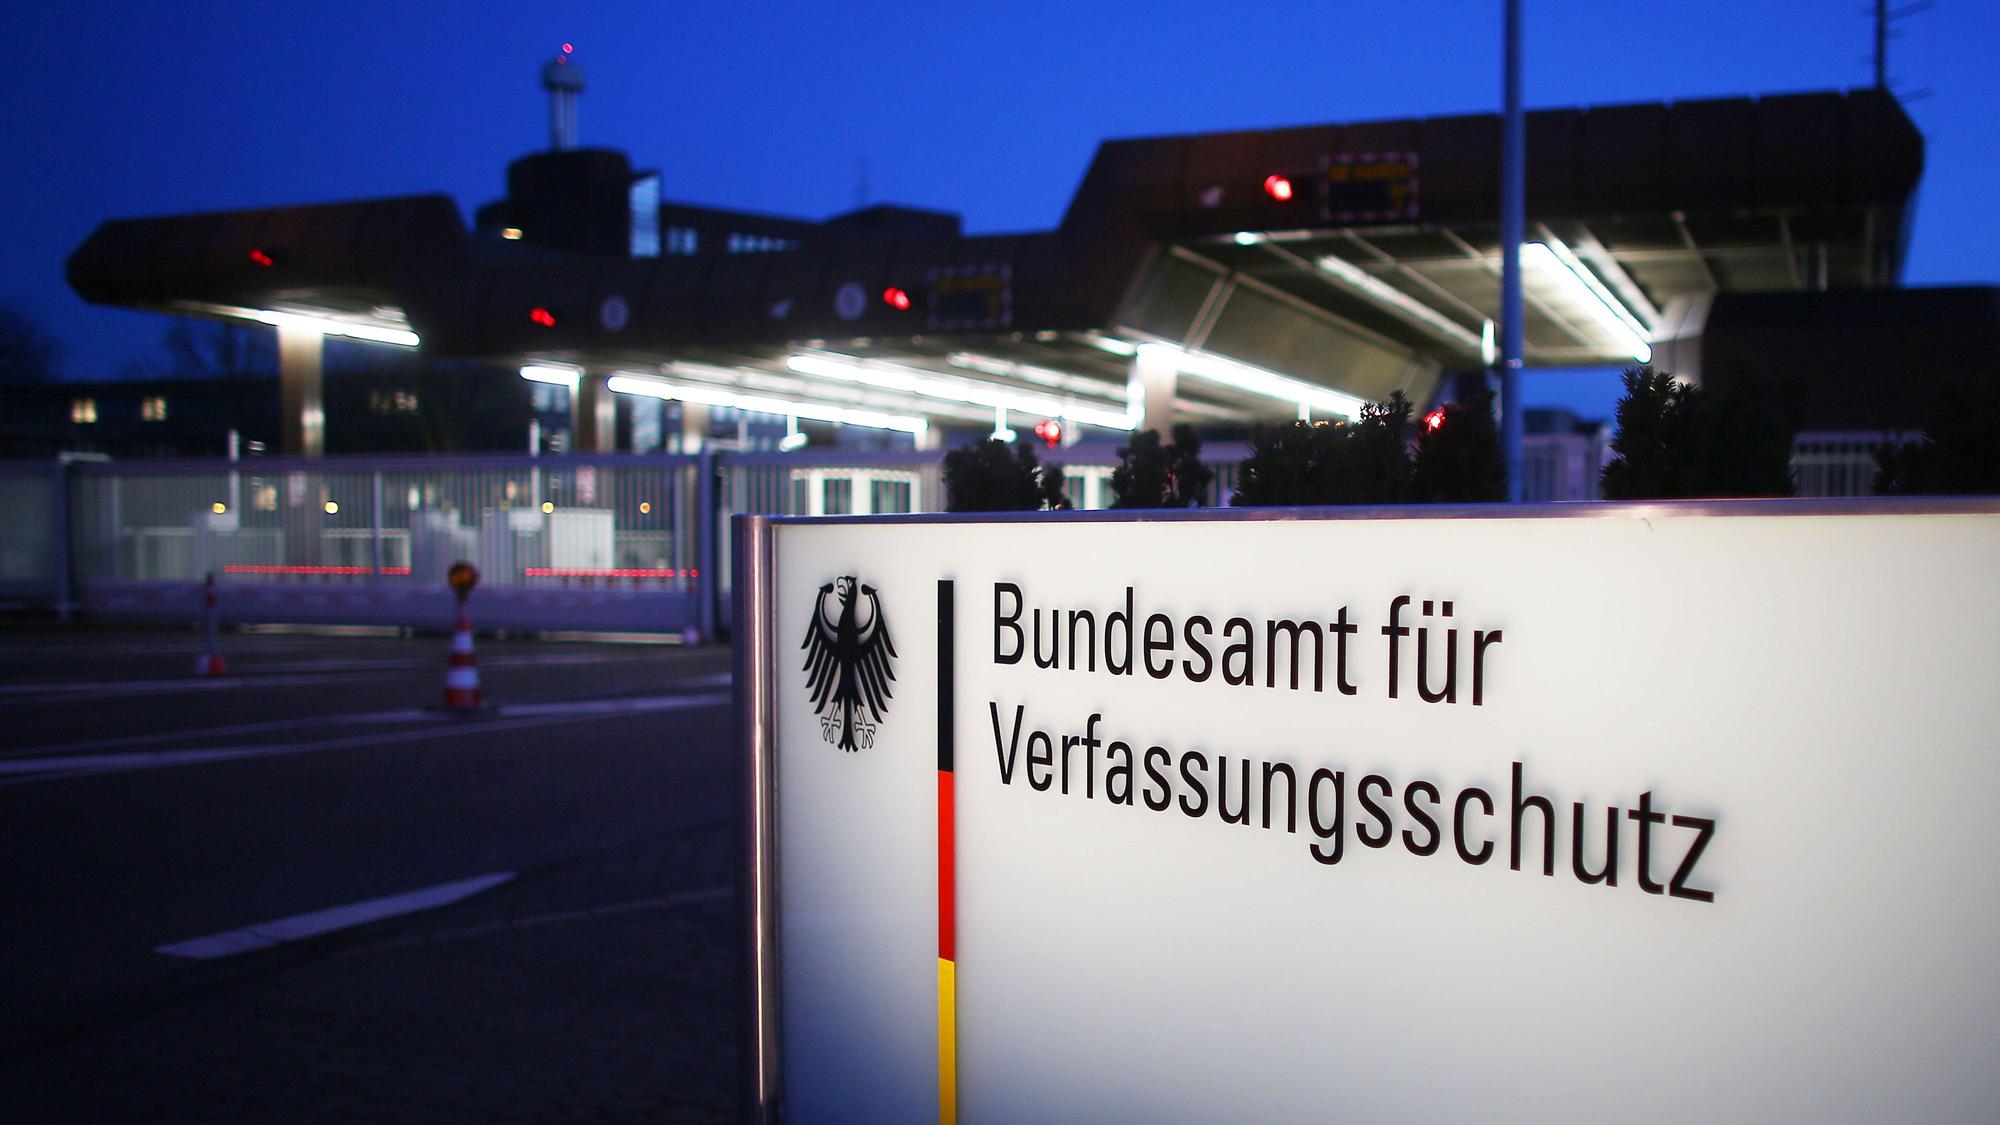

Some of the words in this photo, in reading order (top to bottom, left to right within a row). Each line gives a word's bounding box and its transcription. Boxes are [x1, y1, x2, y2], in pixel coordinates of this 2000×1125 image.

[993, 582, 1358, 696] Bundesamt
[1381, 595, 1503, 706] für
[989, 701, 1716, 903] Verfassungsschutz
